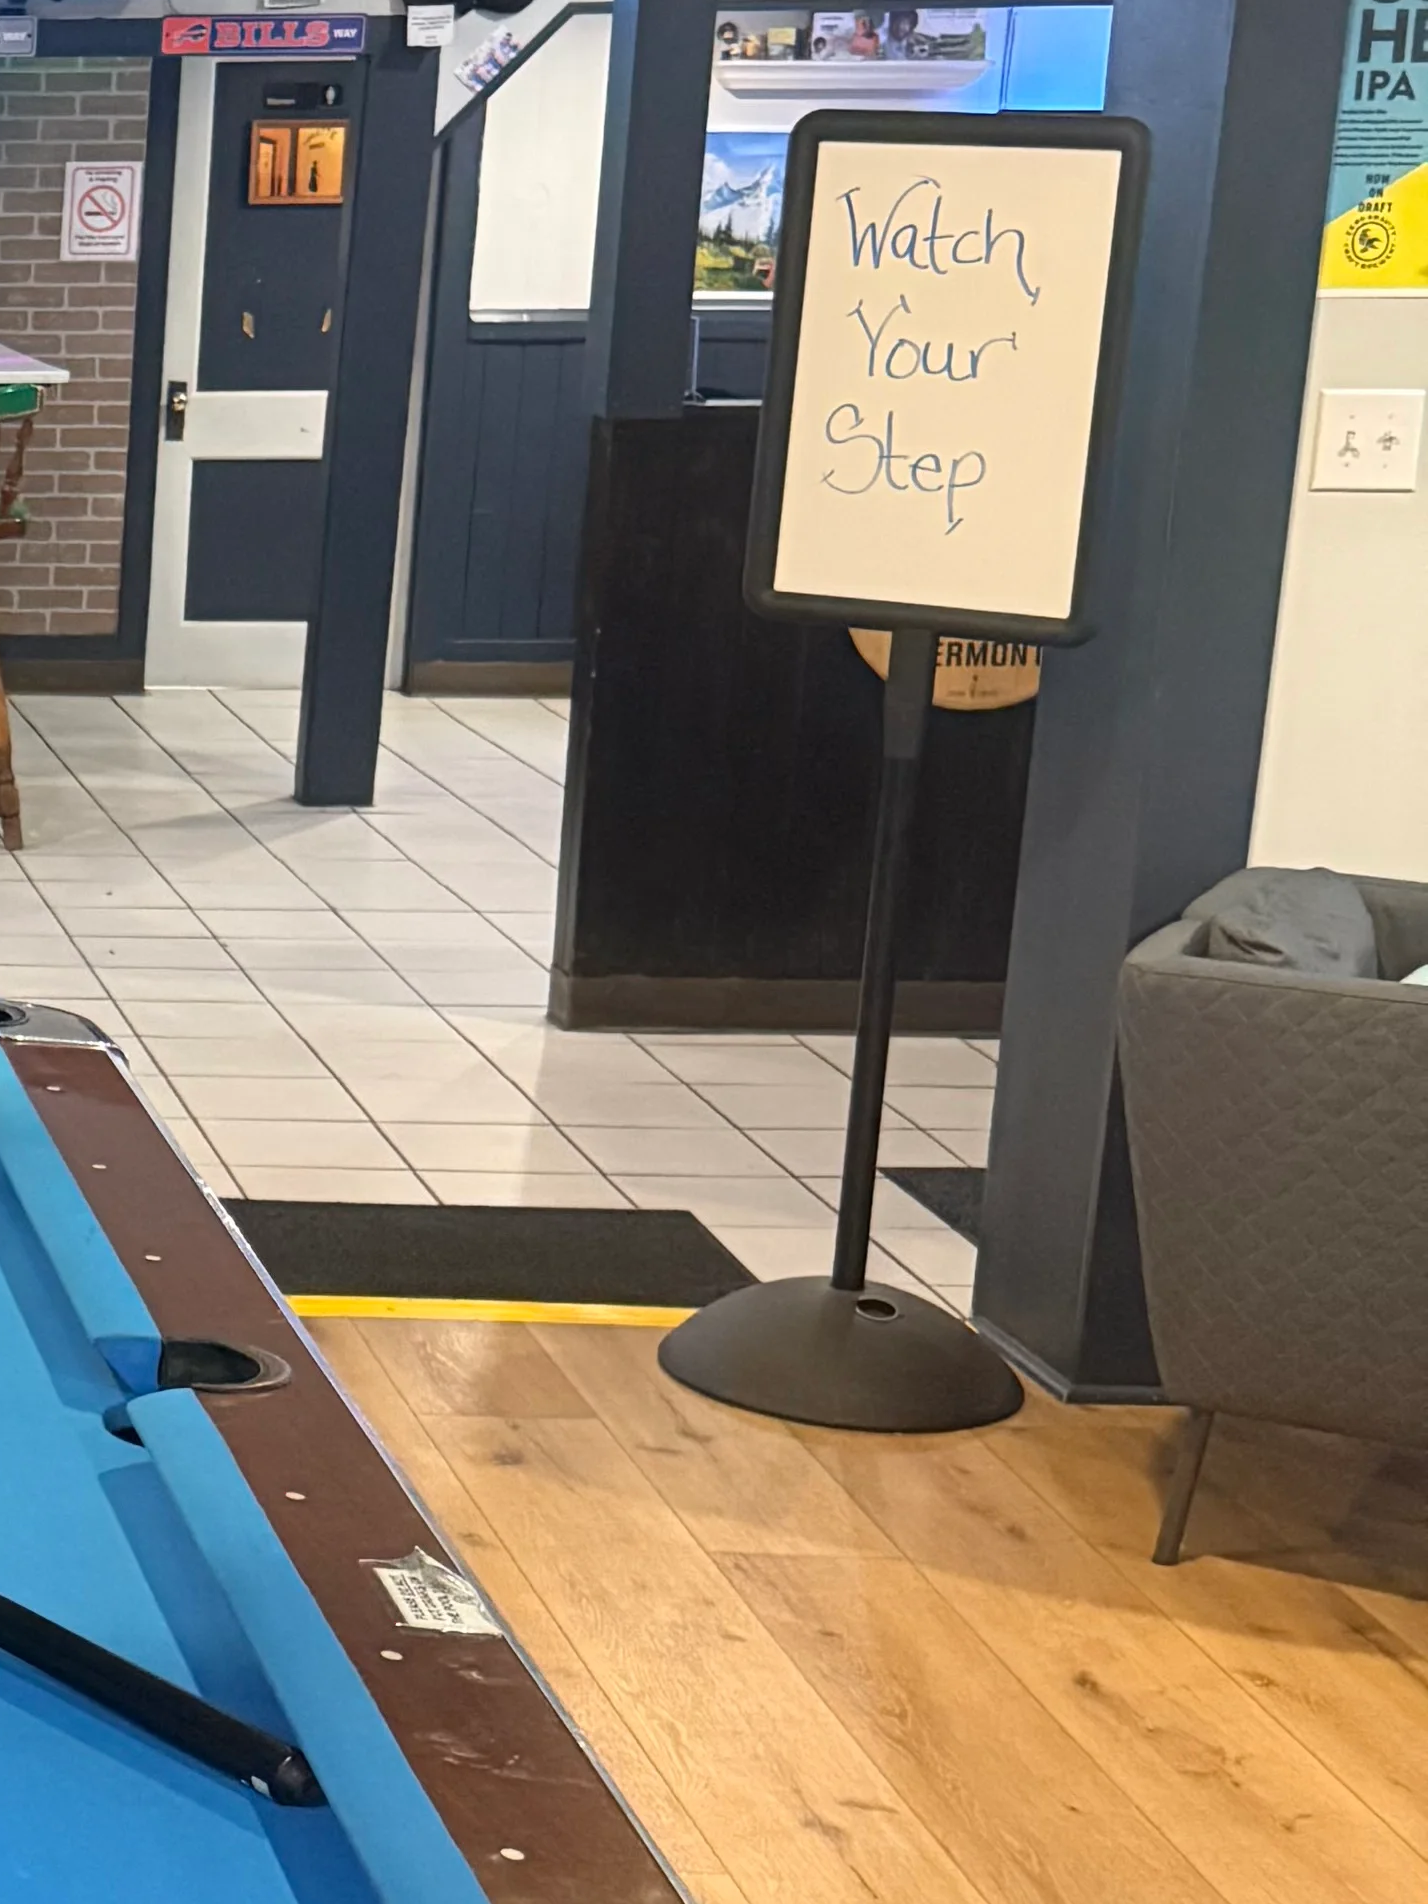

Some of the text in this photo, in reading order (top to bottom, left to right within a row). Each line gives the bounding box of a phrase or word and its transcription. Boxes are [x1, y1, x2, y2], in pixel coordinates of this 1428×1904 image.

[214, 21, 358, 48] BILLS WAY
[1354, 70, 1416, 101] IPA
[1357, 202, 1393, 213] DRAFT
[836, 174, 1041, 306] Watch
[846, 294, 1017, 381] Your
[821, 403, 986, 535] Step
